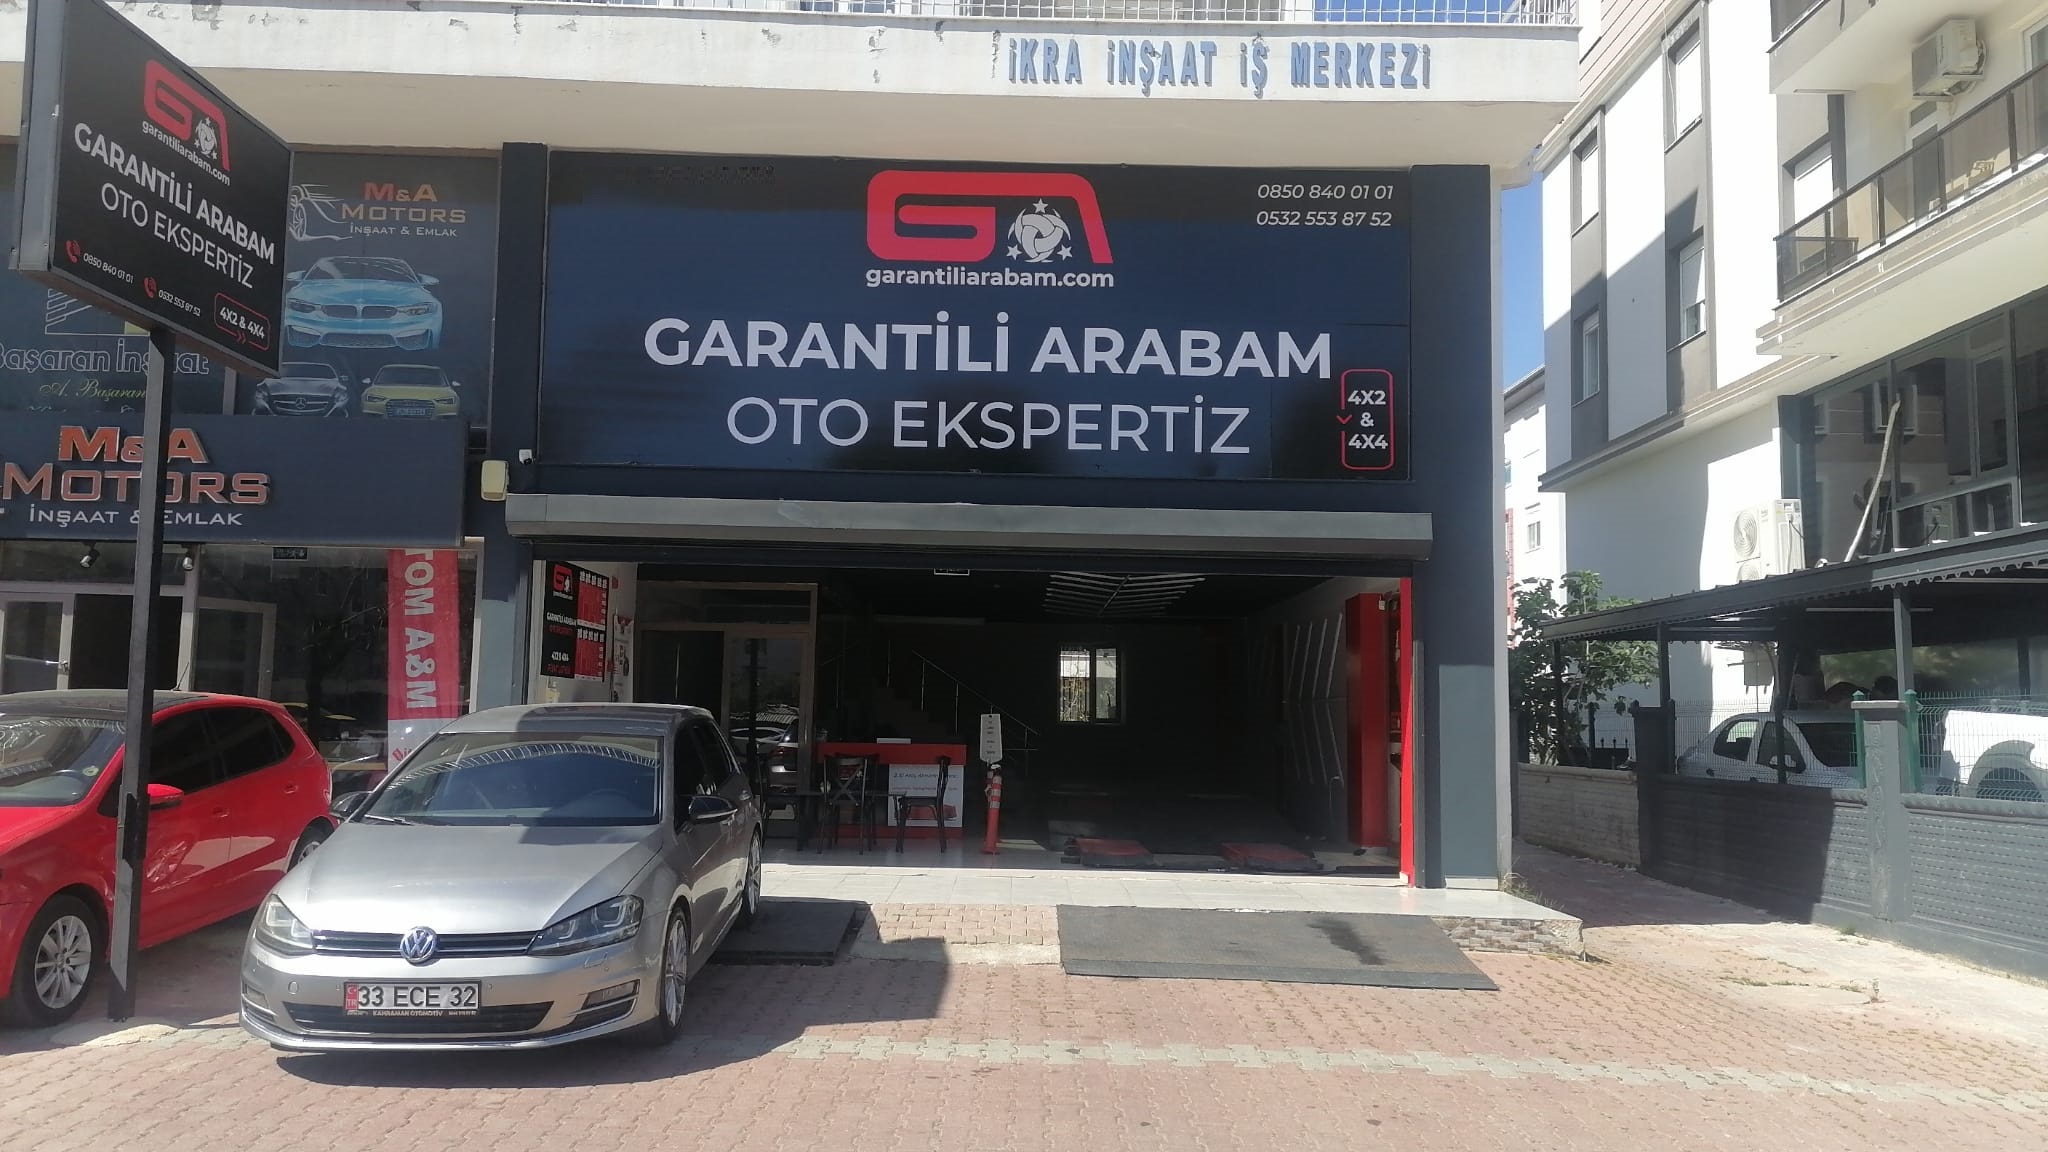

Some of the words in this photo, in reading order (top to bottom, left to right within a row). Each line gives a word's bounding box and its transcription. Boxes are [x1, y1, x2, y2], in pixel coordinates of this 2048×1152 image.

[142, 120, 231, 187] garantiliarabam.com
[74, 122, 193, 214] GARANTİLİ
[196, 199, 275, 265] ARABAM
[364, 182, 437, 202] M&A
[1257, 184, 1304, 199] 0850
[1308, 184, 1345, 199] 840
[1350, 185, 1370, 200] 01
[1374, 185, 1394, 200] 01
[340, 203, 466, 223] MOTORS
[1256, 210, 1301, 226] 0532
[1305, 211, 1338, 226] 553
[1342, 211, 1367, 227] 87
[1369, 212, 1392, 227] 52
[101, 182, 148, 227] OTO
[154, 210, 254, 289] EKSPERTİZ
[400, 226, 410, 235] &
[83, 252, 102, 269] 0850
[102, 262, 117, 276] 840
[117, 269, 126, 280] 01
[126, 273, 134, 284] 01
[866, 266, 1114, 288] garantiliarabam.com
[158, 289, 173, 303] 0532
[173, 295, 185, 309] 553
[219, 306, 238, 326] 4X2
[238, 315, 246, 328] &
[247, 320, 265, 339] 4X4
[644, 310, 1009, 372] GARANTİLİ
[1030, 326, 1331, 379] ARABAM
[1347, 390, 1386, 405] 4X2
[727, 396, 869, 446] OTO
[893, 394, 1250, 454] EKSPERTİZ
[1360, 412, 1375, 427] &
[58, 425, 208, 463] M&A
[1348, 434, 1389, 450] 4X4
[358, 985, 384, 1007] 33
[393, 986, 441, 1007] ECE
[450, 986, 476, 1007] 32
